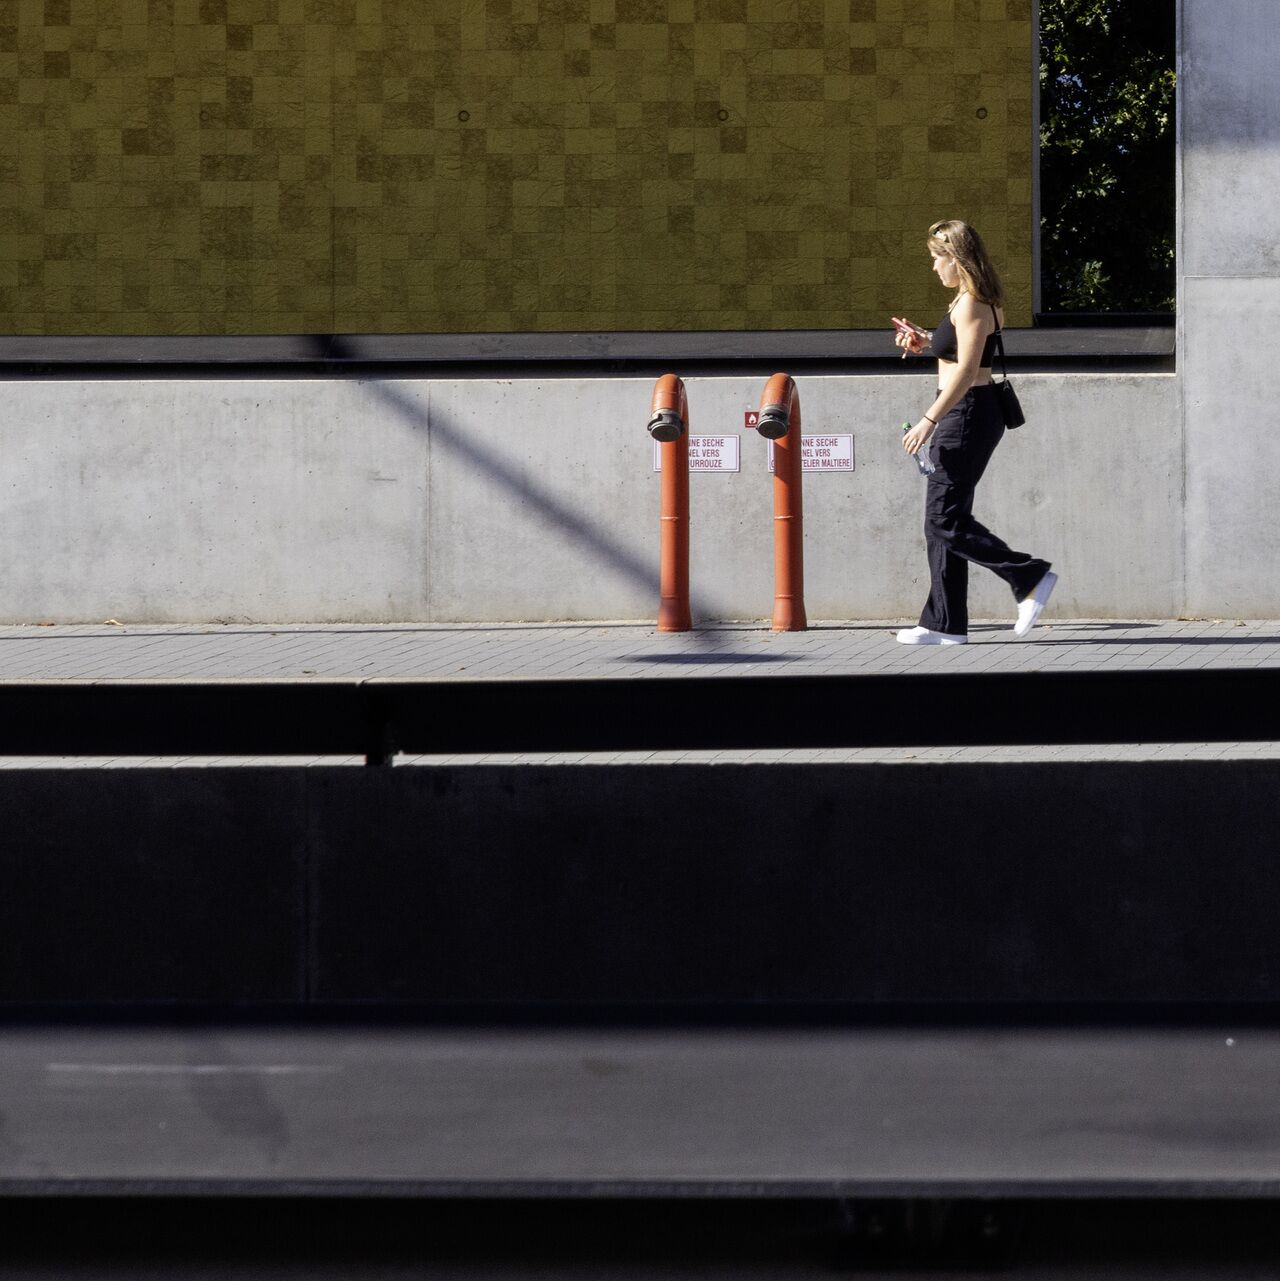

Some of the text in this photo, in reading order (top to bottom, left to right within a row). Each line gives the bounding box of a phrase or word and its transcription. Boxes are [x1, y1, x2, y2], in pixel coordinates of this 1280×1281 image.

[702, 438, 725, 447] SECHE
[816, 438, 838, 447] SECHE
[702, 449, 720, 458] VERS
[815, 449, 831, 457] VERS
[821, 458, 850, 467] MALTIERE
